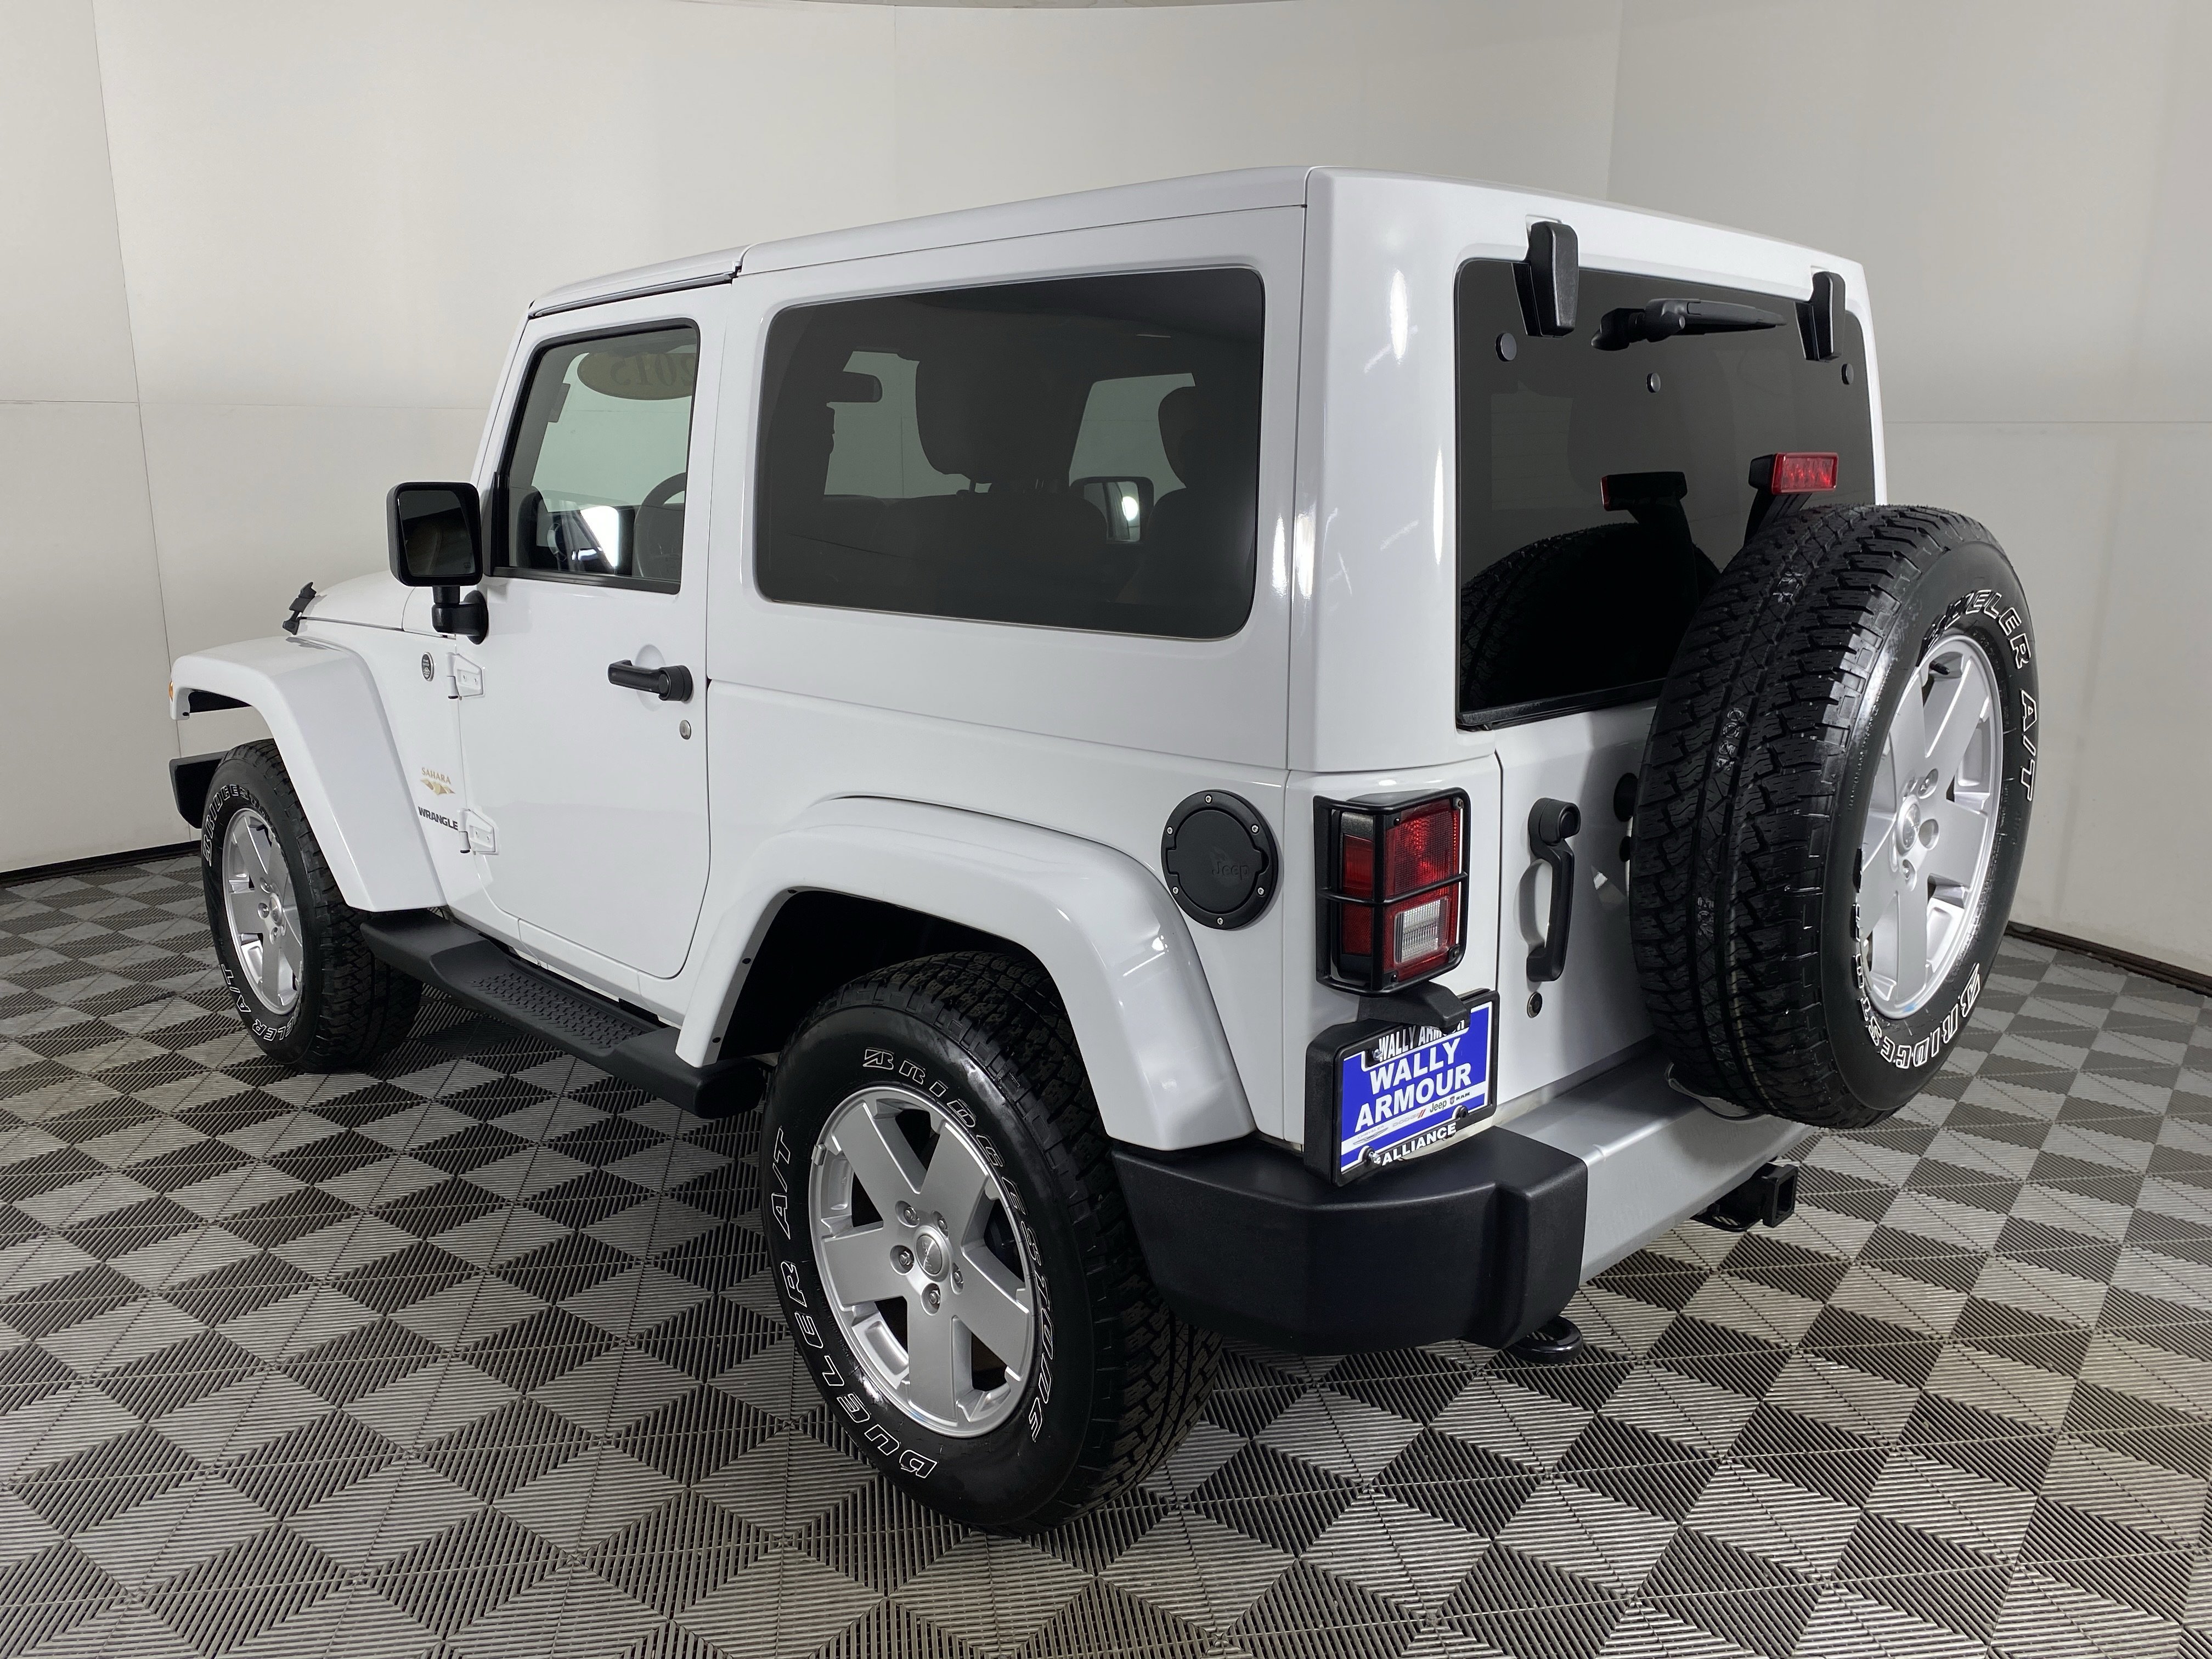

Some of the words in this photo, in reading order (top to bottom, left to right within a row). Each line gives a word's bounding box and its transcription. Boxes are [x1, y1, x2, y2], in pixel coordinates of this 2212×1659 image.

[2020, 689, 2037, 802] A/T
[421, 767, 451, 785] SAHARA
[417, 806, 459, 831] WRANGLE
[1211, 861, 1249, 880] Jeep
[221, 964, 251, 1012] A/T
[1379, 1025, 1417, 1062] WALLY
[1370, 1037, 1460, 1094] WALLY
[1354, 1062, 1471, 1132] ARMOUR
[1430, 1099, 1447, 1113] Jeep
[1455, 1092, 1470, 1101] RAM
[1357, 1125, 1384, 1139] CHRYSLER
[1392, 1113, 1420, 1127] DODGE
[1381, 1122, 1457, 1166] ALLIANCE
[771, 1126, 791, 1240] A/T
[862, 1047, 1054, 1443] BRIDGESTONE
[781, 1261, 938, 1478] DUELER
